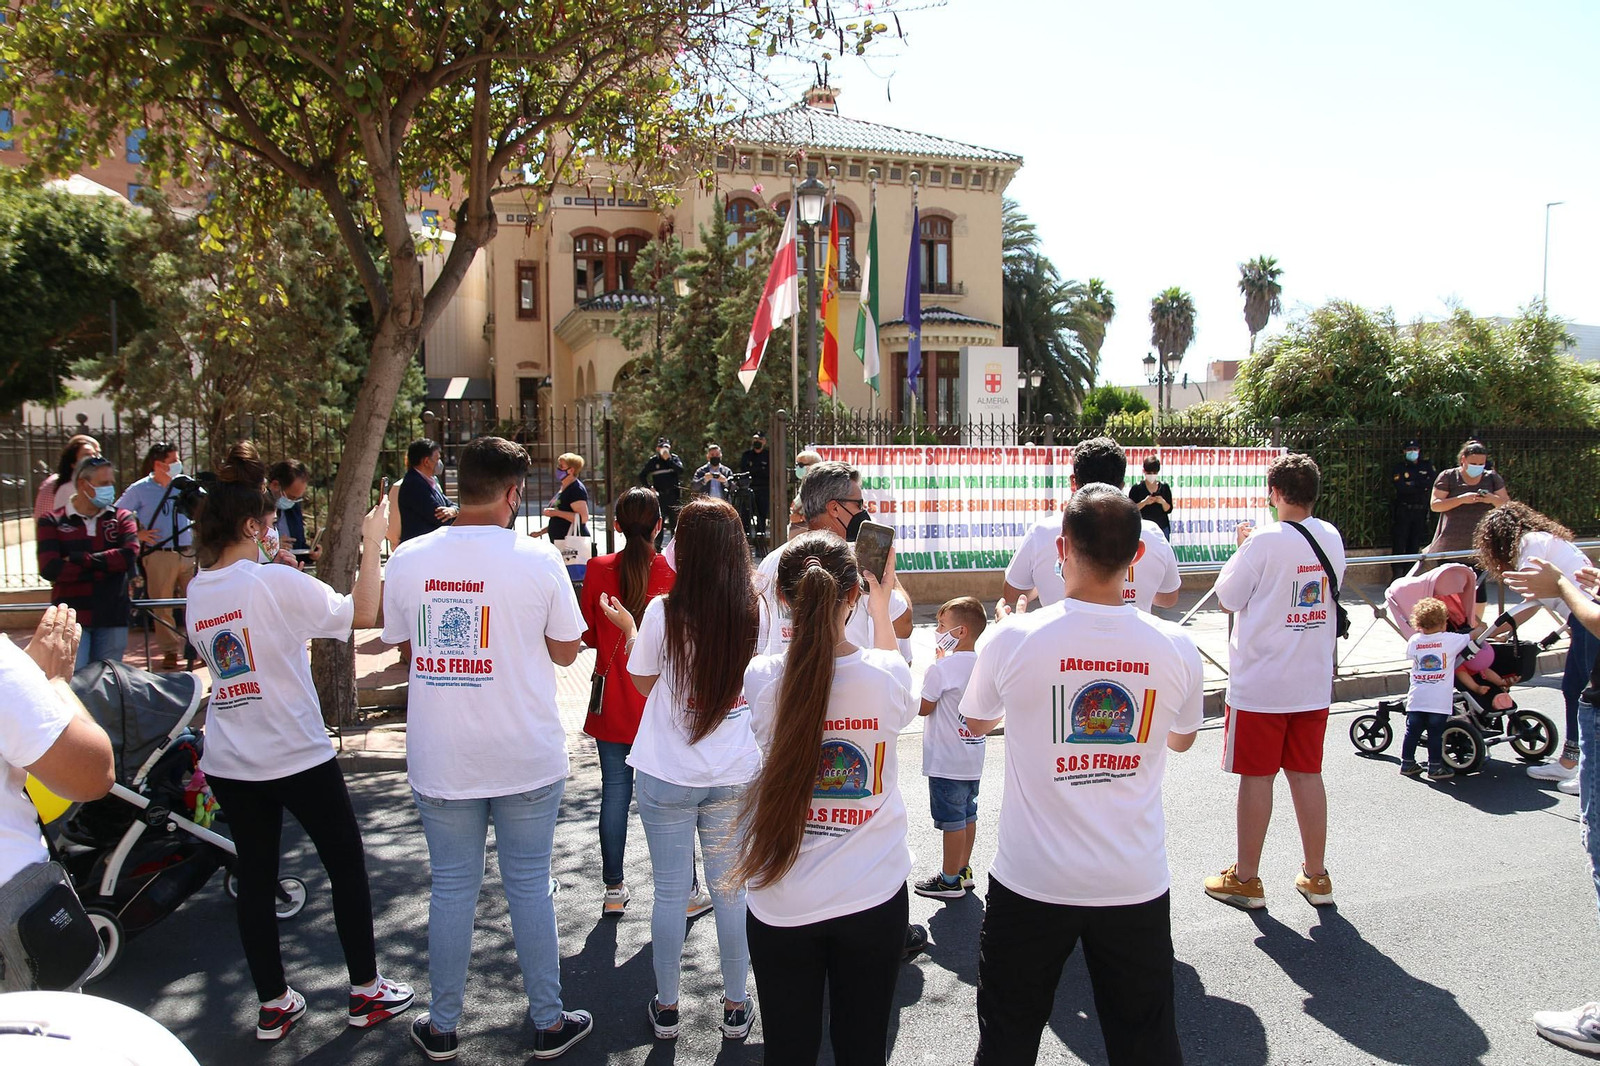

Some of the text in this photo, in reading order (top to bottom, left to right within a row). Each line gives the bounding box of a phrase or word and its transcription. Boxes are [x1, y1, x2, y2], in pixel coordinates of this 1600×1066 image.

[977, 396, 1009, 404] ALMERÍA
[925, 447, 1002, 466] SOLUCIONES
[1005, 447, 1019, 466] YA
[1023, 447, 1053, 466] PARA
[1160, 449, 1216, 466] FERIANTES
[1218, 450, 1231, 466] DE
[893, 476, 961, 490] TRABAJAR
[986, 475, 1029, 489] FERIAS
[1032, 475, 1053, 489] SIN
[1177, 475, 1209, 488] COMO
[880, 500, 898, 514] DE
[902, 500, 916, 514] 18
[919, 499, 965, 514] MESES
[967, 499, 989, 512] SIN
[993, 498, 1058, 512] INGRESOS
[1173, 497, 1216, 509] ENEMOS
[1218, 496, 1248, 509] PARA
[919, 523, 969, 539] EJERCER
[971, 522, 1025, 538] NUESTRA
[1187, 520, 1215, 533] OTRO
[935, 551, 950, 570] DE
[425, 578, 484, 593] ¡Atención!
[416, 657, 493, 674] S.O.S FERIAS
[228, 682, 261, 698] FERIAS
[1056, 753, 1142, 774] S.O.S FERIAS
